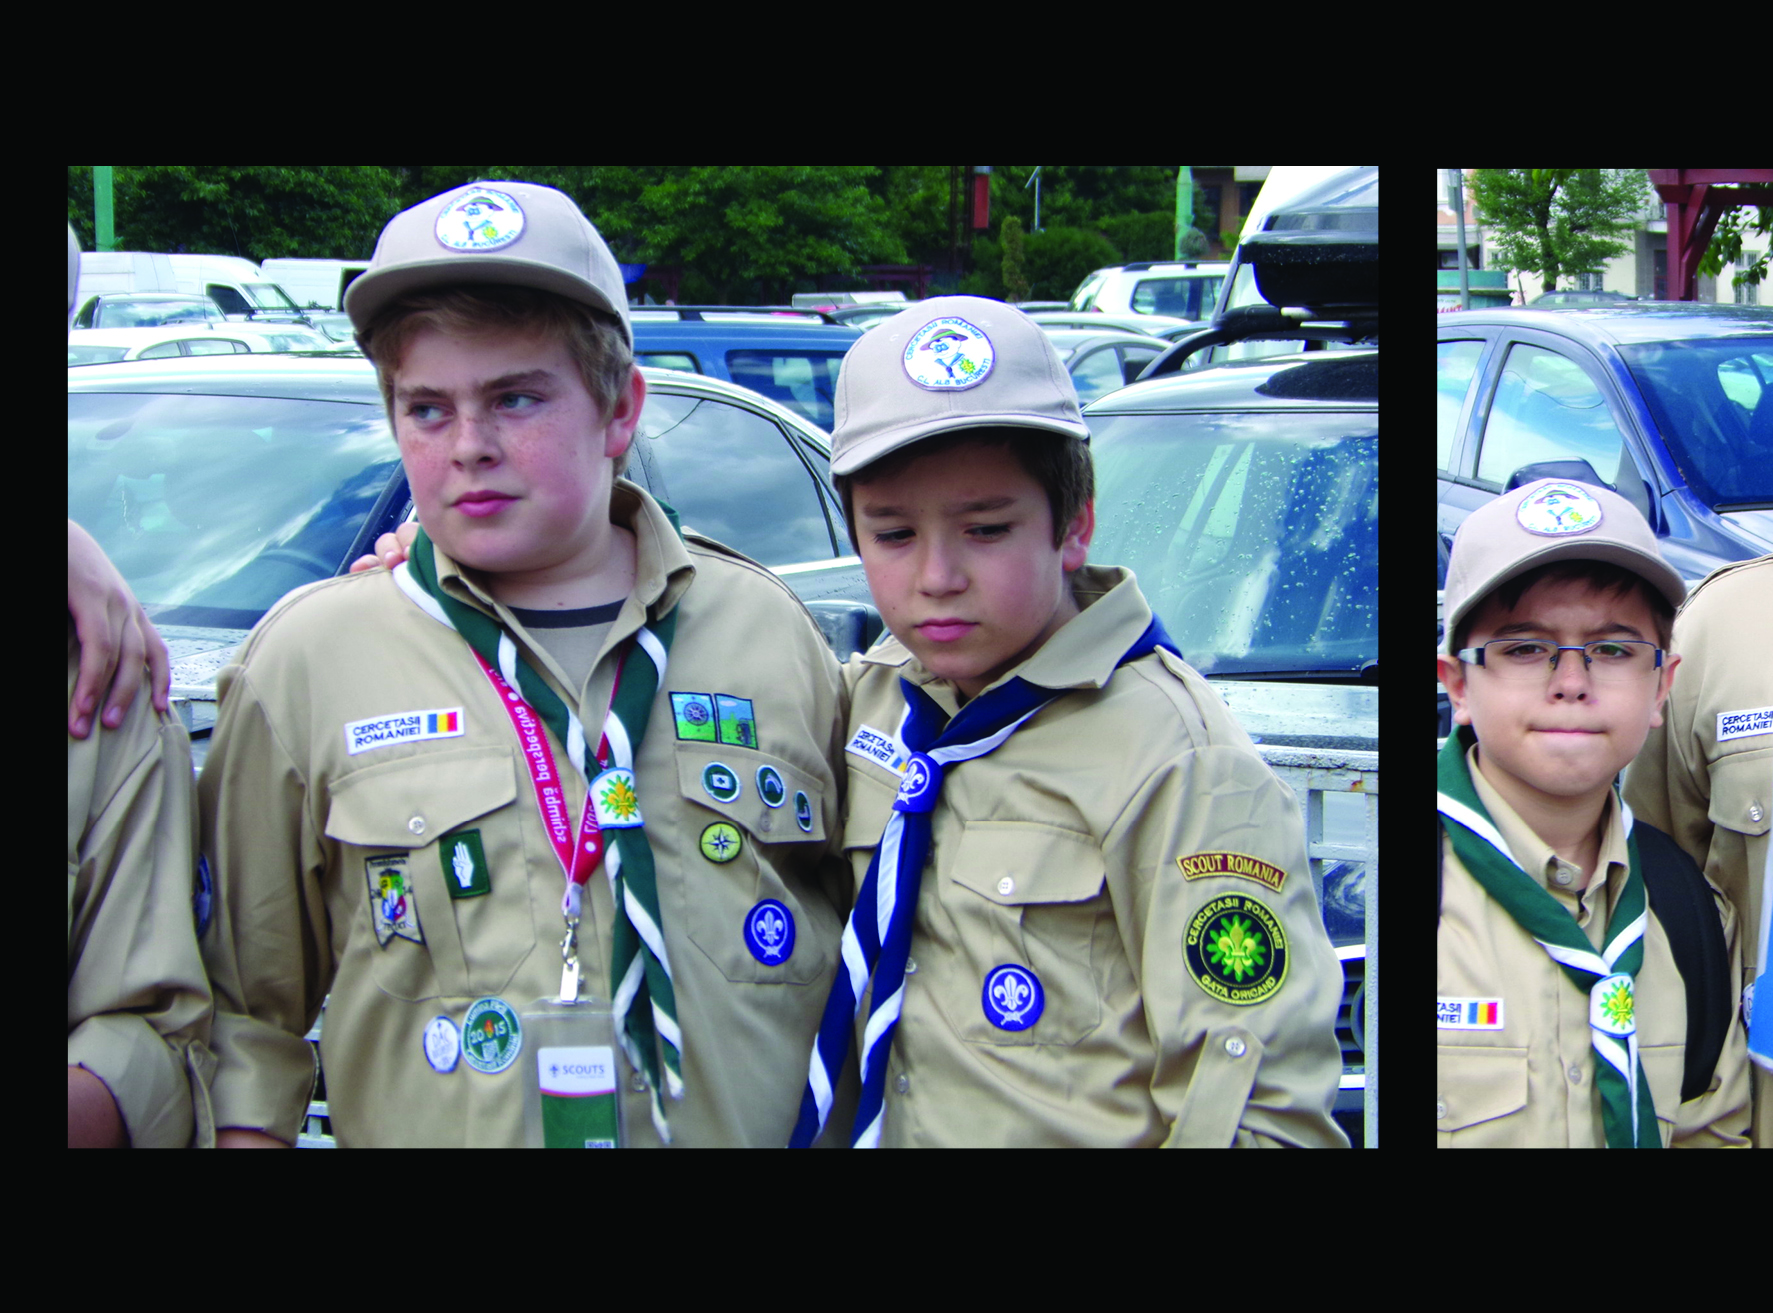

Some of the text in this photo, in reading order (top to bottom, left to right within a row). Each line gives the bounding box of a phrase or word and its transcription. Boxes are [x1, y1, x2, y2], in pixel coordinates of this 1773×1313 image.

[905, 319, 984, 360] CERCETASII ROMANIEI
[352, 716, 421, 737] CERCETASII
[1722, 710, 1773, 726] CERCETASII
[1722, 720, 1773, 736] ROMANIEI
[354, 727, 421, 748] ROMANIEI
[1183, 855, 1281, 888] SCOUT ROMANIA
[1188, 898, 1284, 949] CERCETASII ROMANIEI
[1201, 974, 1276, 1000] GATA ORICAND
[562, 1065, 604, 1075] SCOUTS
